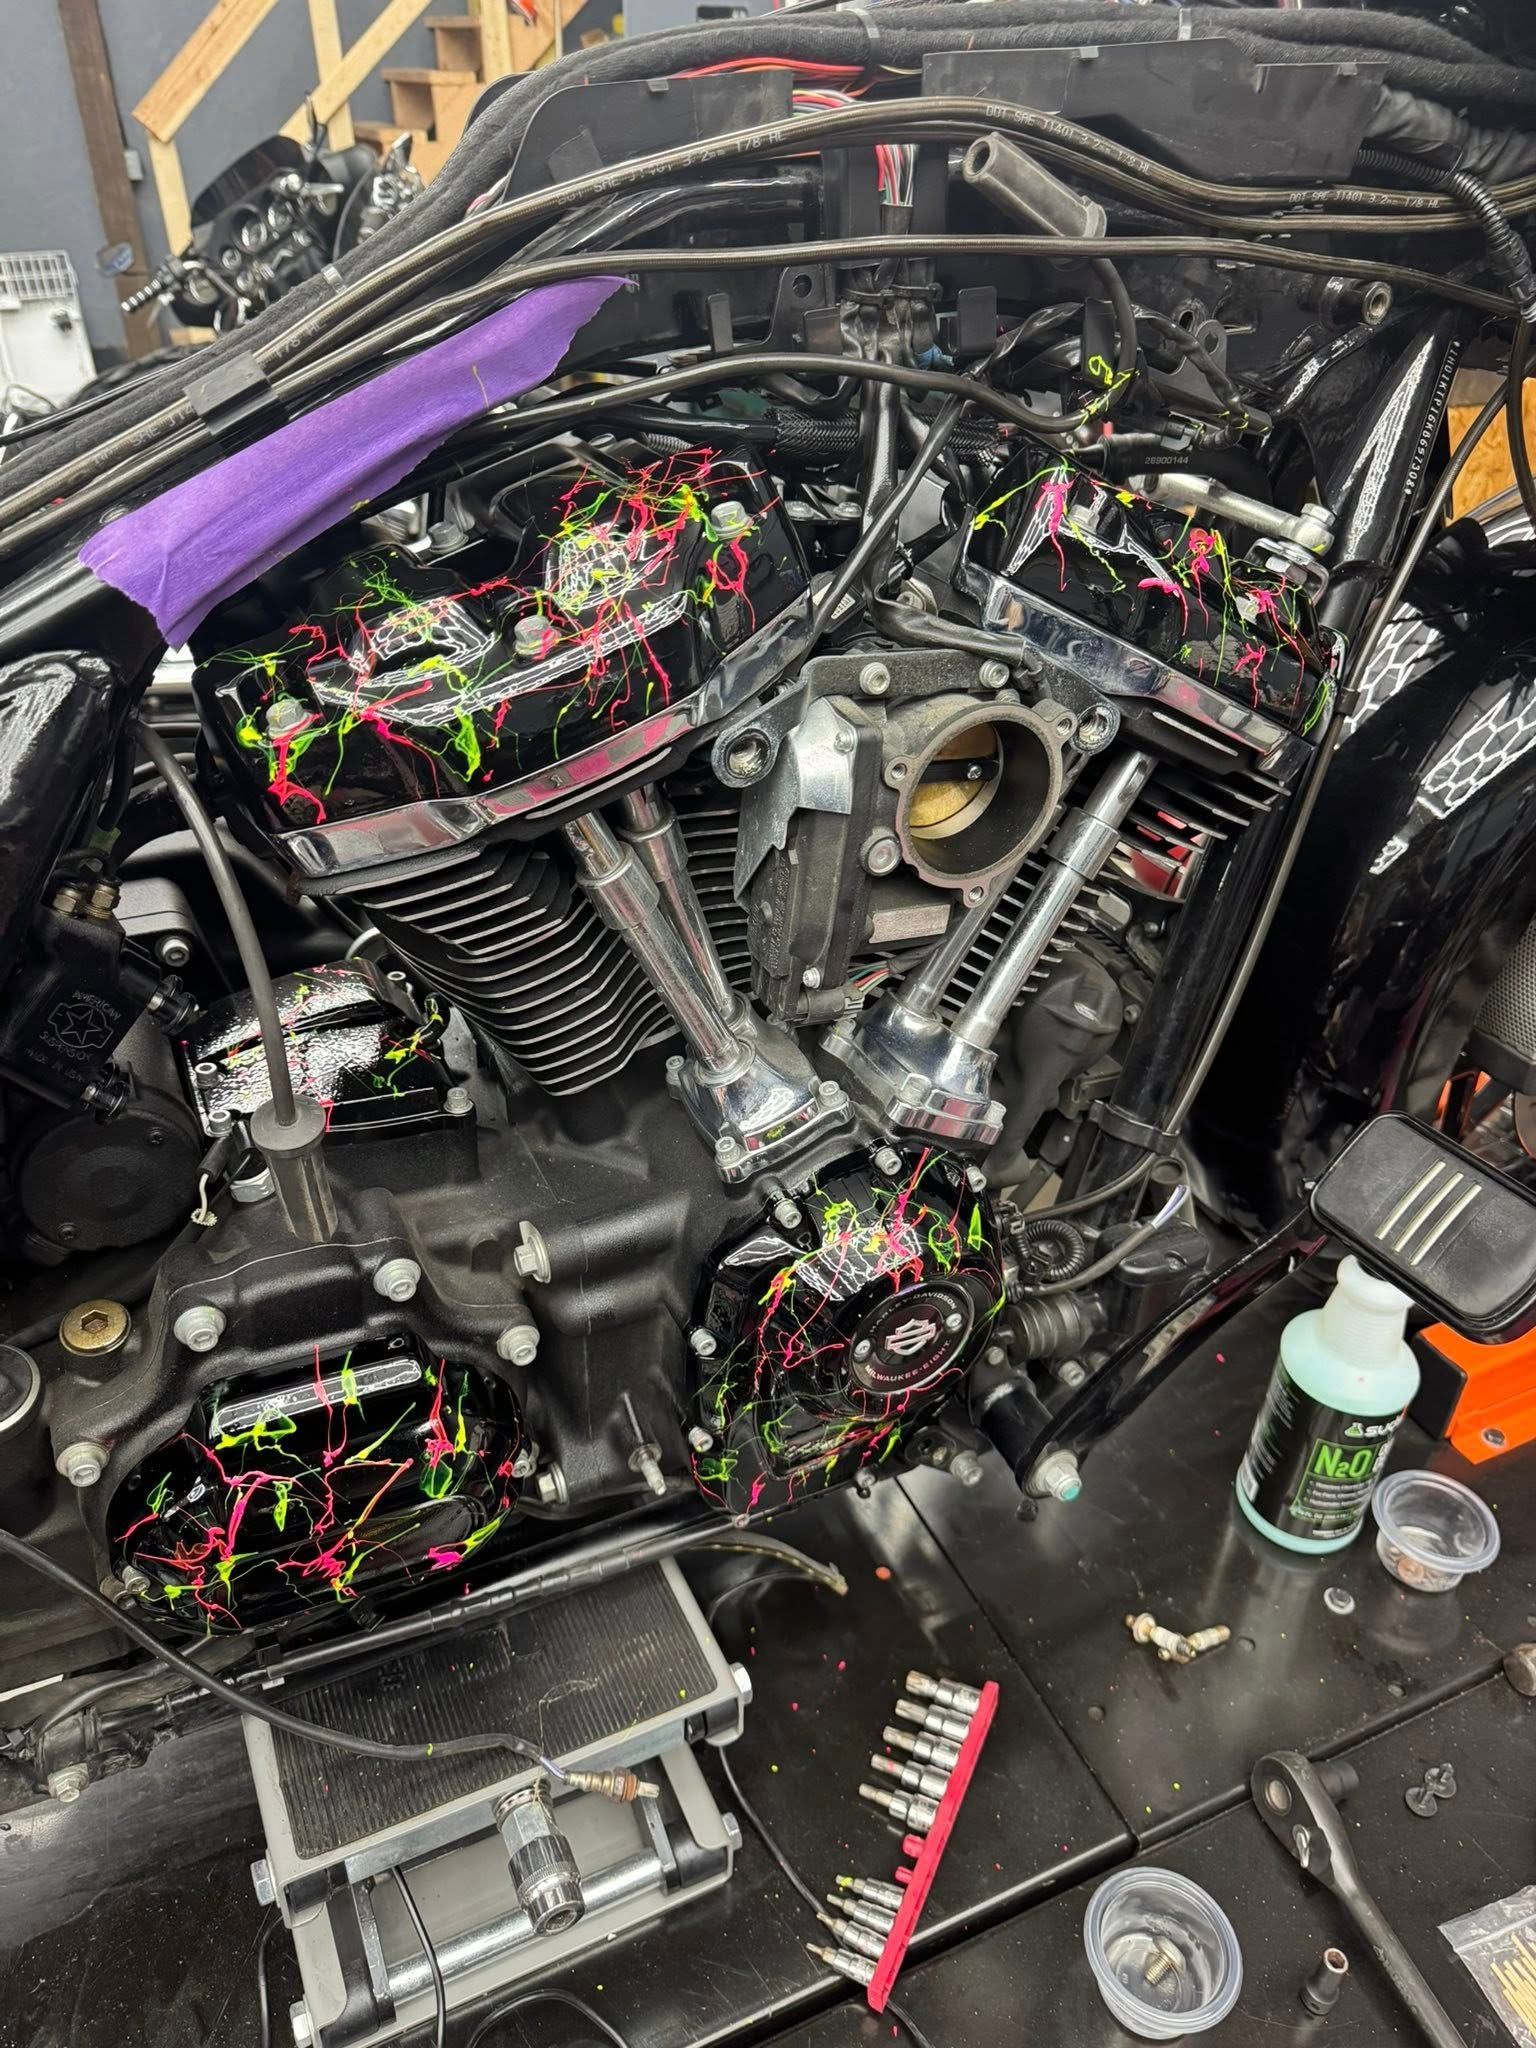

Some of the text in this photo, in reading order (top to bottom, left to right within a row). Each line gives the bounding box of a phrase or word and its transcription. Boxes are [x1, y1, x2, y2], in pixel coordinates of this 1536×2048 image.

[593, 178, 622, 194] SAE
[768, 130, 788, 144] HL
[986, 105, 1007, 118] DOT
[1014, 111, 1036, 126] SAE
[1043, 119, 1075, 142] J1401
[1117, 150, 1138, 168] 1/8
[1139, 161, 1152, 176] HL
[1288, 193, 1307, 204] DOT
[1312, 191, 1330, 201] SAE
[1334, 190, 1363, 202] J1401
[1404, 196, 1424, 208] 1/8
[1428, 199, 1441, 209] HL
[864, 1339, 952, 1383] MILWAUKEE-EIGHT
[1314, 1444, 1373, 1478] N2O
